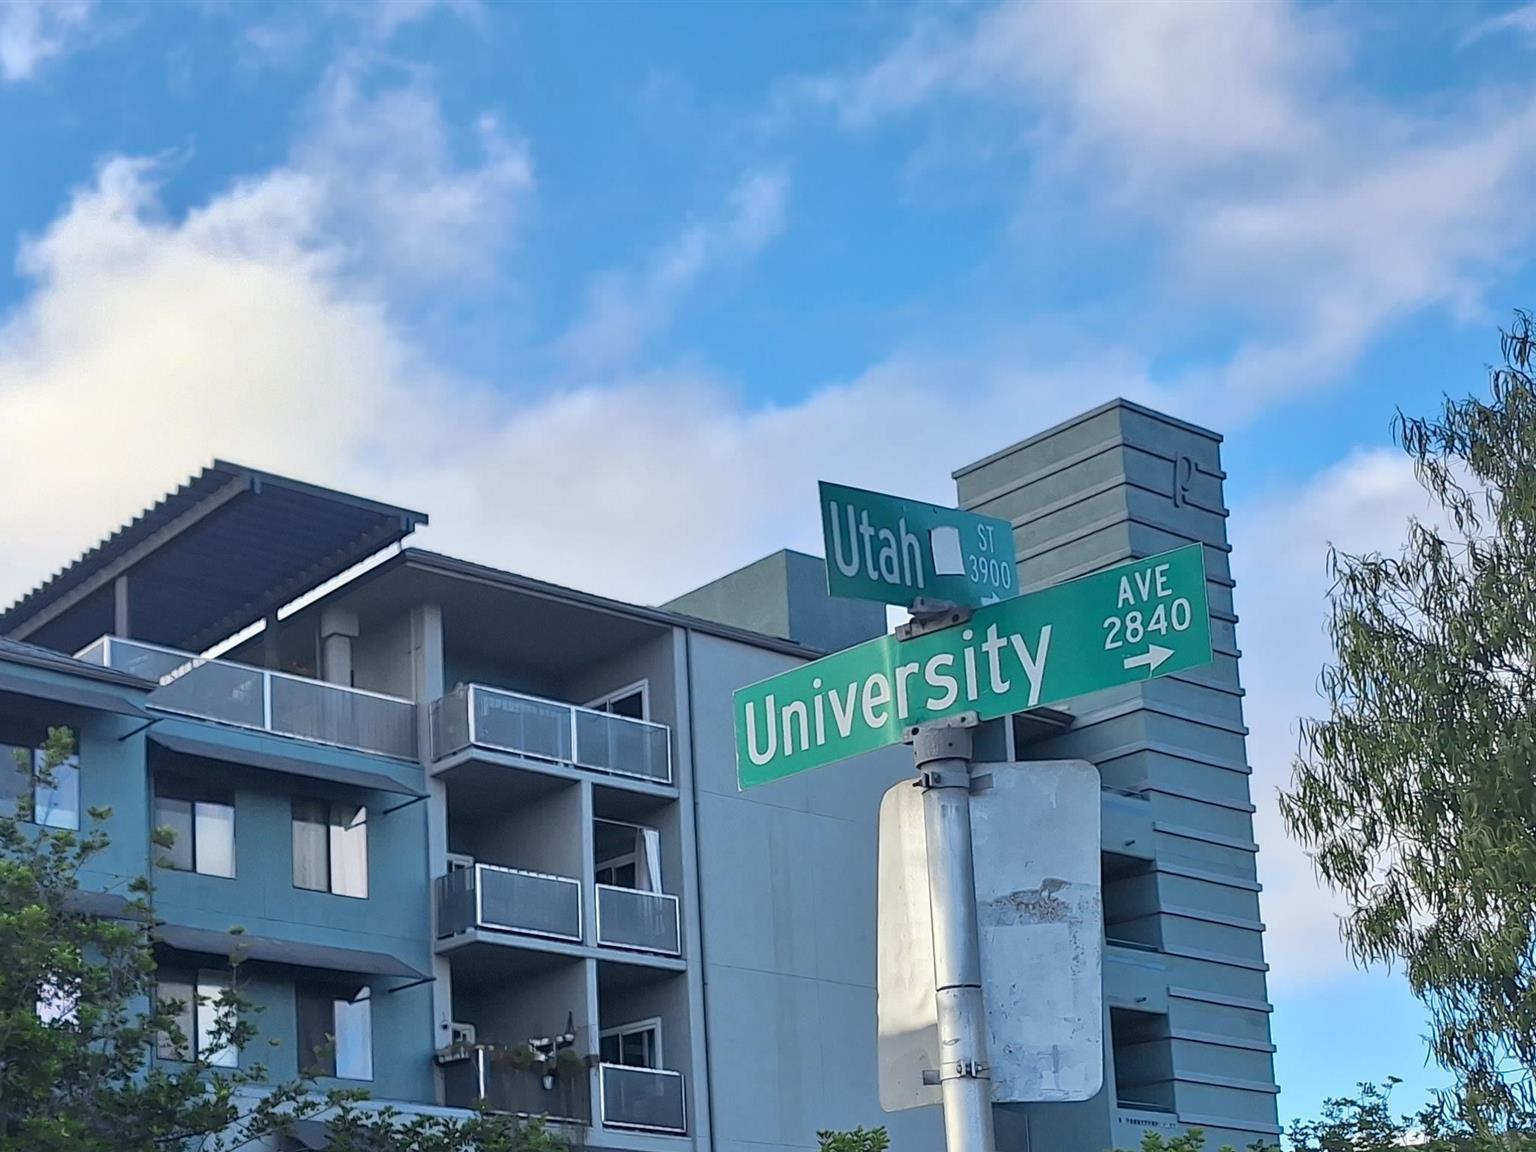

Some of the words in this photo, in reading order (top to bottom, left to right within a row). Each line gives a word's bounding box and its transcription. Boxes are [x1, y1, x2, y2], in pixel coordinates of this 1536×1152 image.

[829, 501, 925, 590] Utah
[977, 524, 995, 554] ST
[969, 555, 1011, 590] 3900
[1117, 562, 1173, 609] AVE
[1103, 597, 1191, 651] 2840
[744, 622, 1053, 767] University
